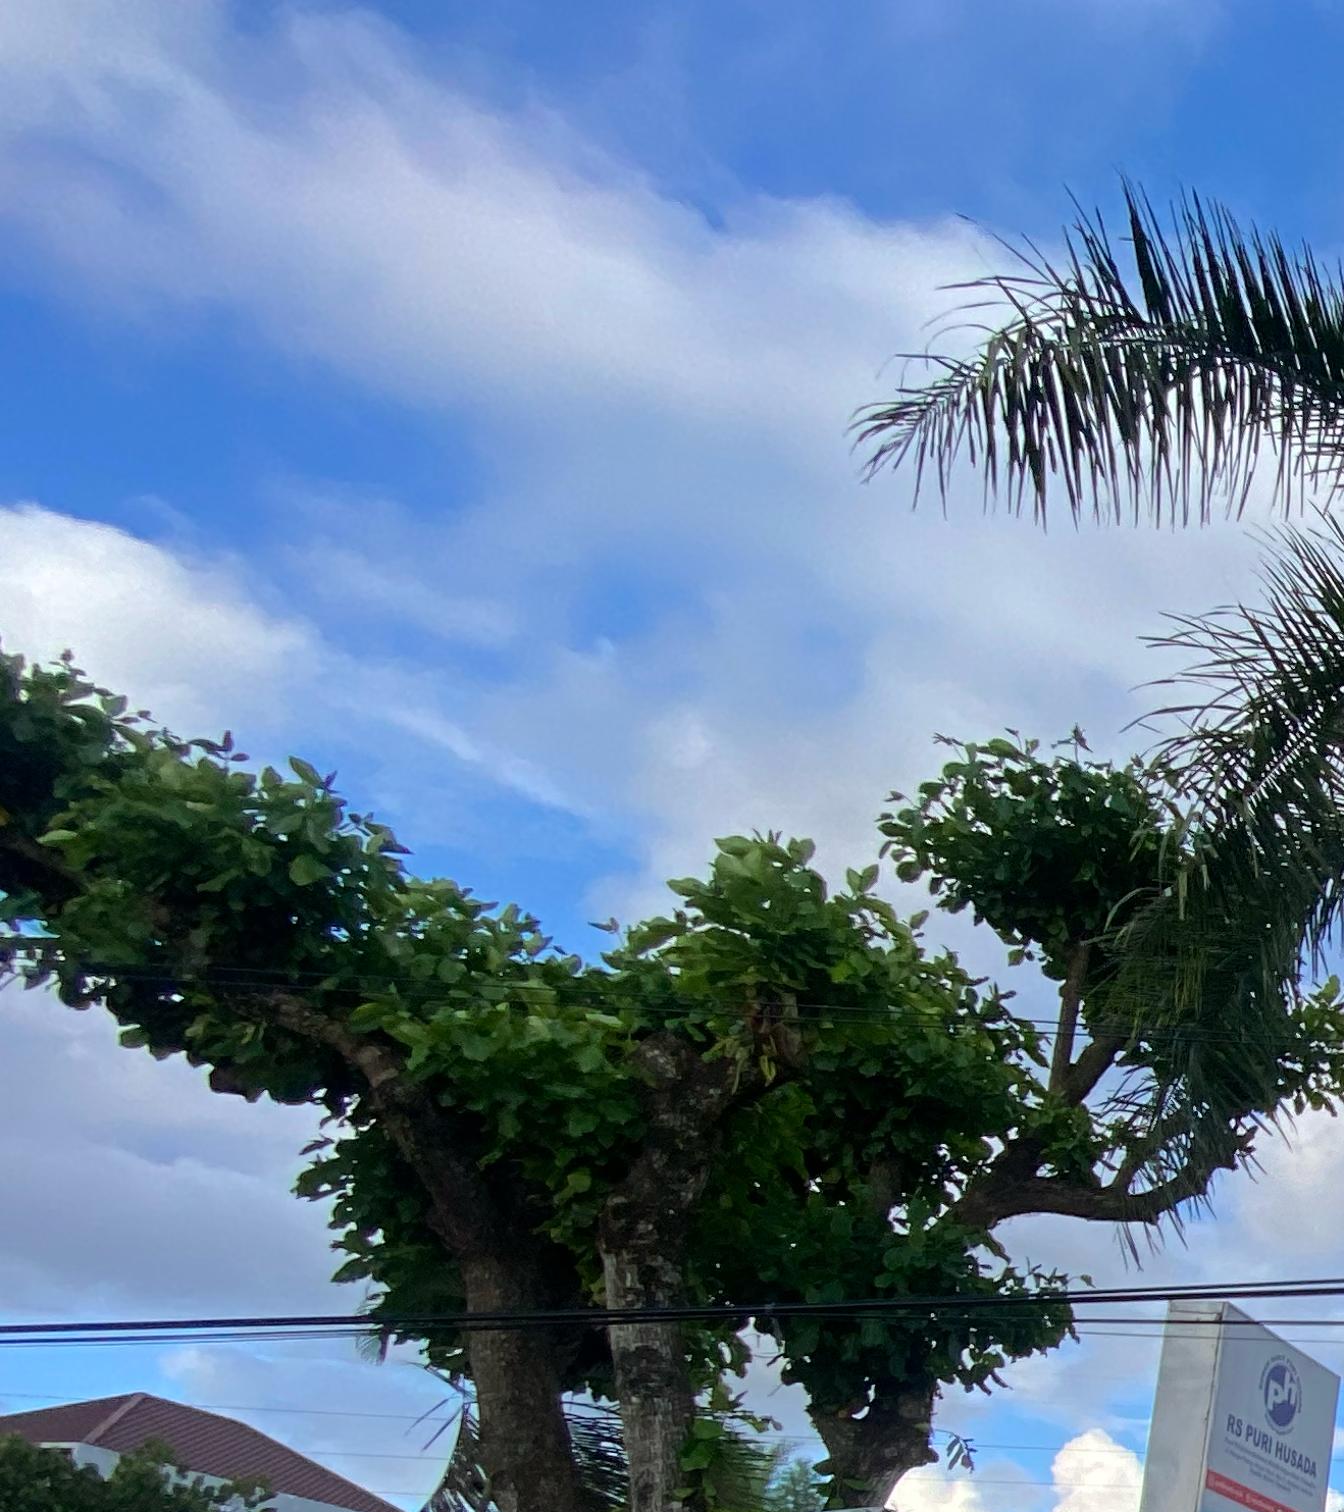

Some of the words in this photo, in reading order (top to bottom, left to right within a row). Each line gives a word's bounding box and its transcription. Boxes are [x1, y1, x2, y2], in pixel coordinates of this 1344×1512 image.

[1226, 1413, 1243, 1437] RS
[1245, 1424, 1273, 1454] PURI
[1275, 1441, 1318, 1479] HUSADA
